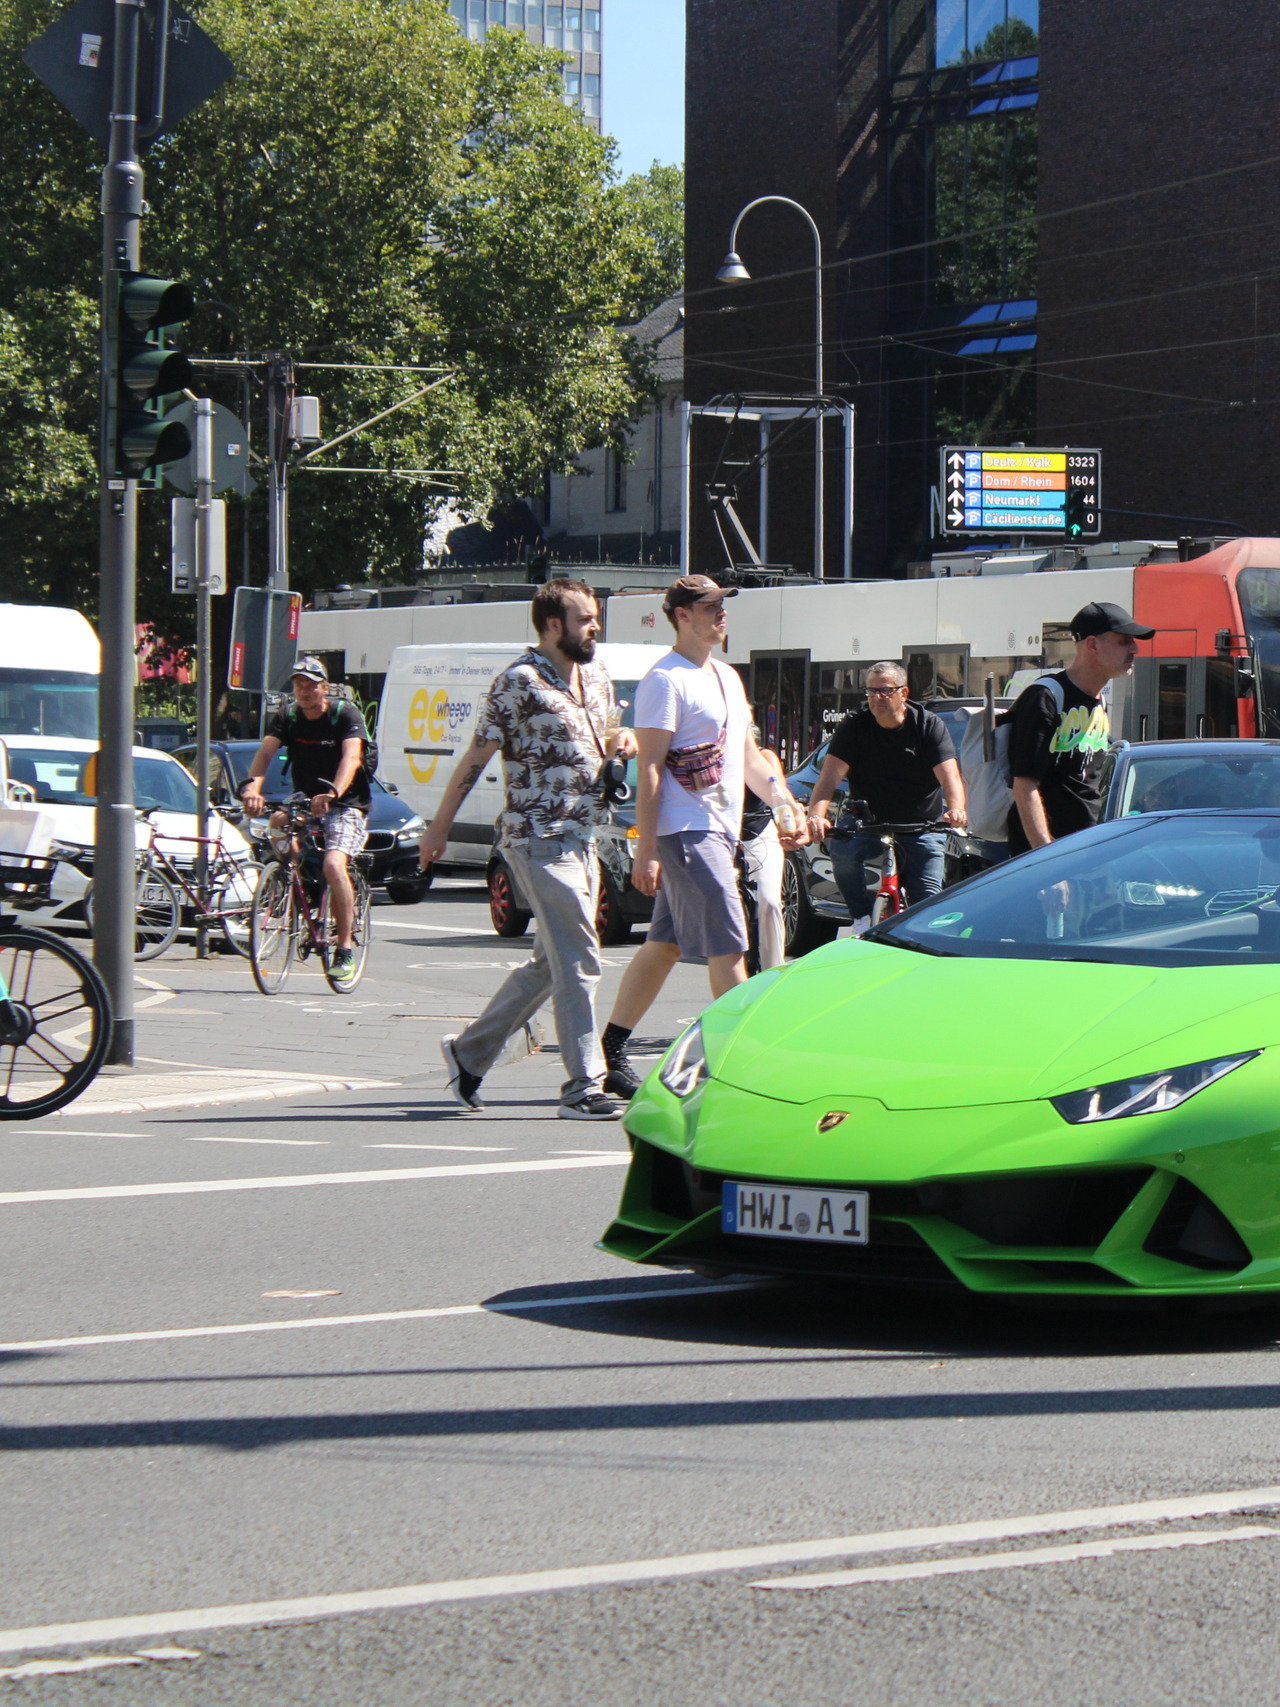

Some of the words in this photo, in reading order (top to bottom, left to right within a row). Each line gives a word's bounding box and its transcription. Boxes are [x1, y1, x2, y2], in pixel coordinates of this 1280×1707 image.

[985, 455, 1016, 467] Deutz
[1026, 457, 1052, 468] Kalk
[1068, 456, 1095, 468] 3323
[985, 475, 1011, 486] Dom
[1021, 476, 1052, 487] Rhein
[1070, 475, 1096, 486] 1604
[985, 494, 1041, 506] Neumarkt
[984, 512, 1062, 525] Cäcilienstraße
[1086, 513, 1095, 524] 0
[437, 696, 471, 722] wheego
[822, 709, 846, 722] Grüner
[740, 1191, 793, 1231] HWI
